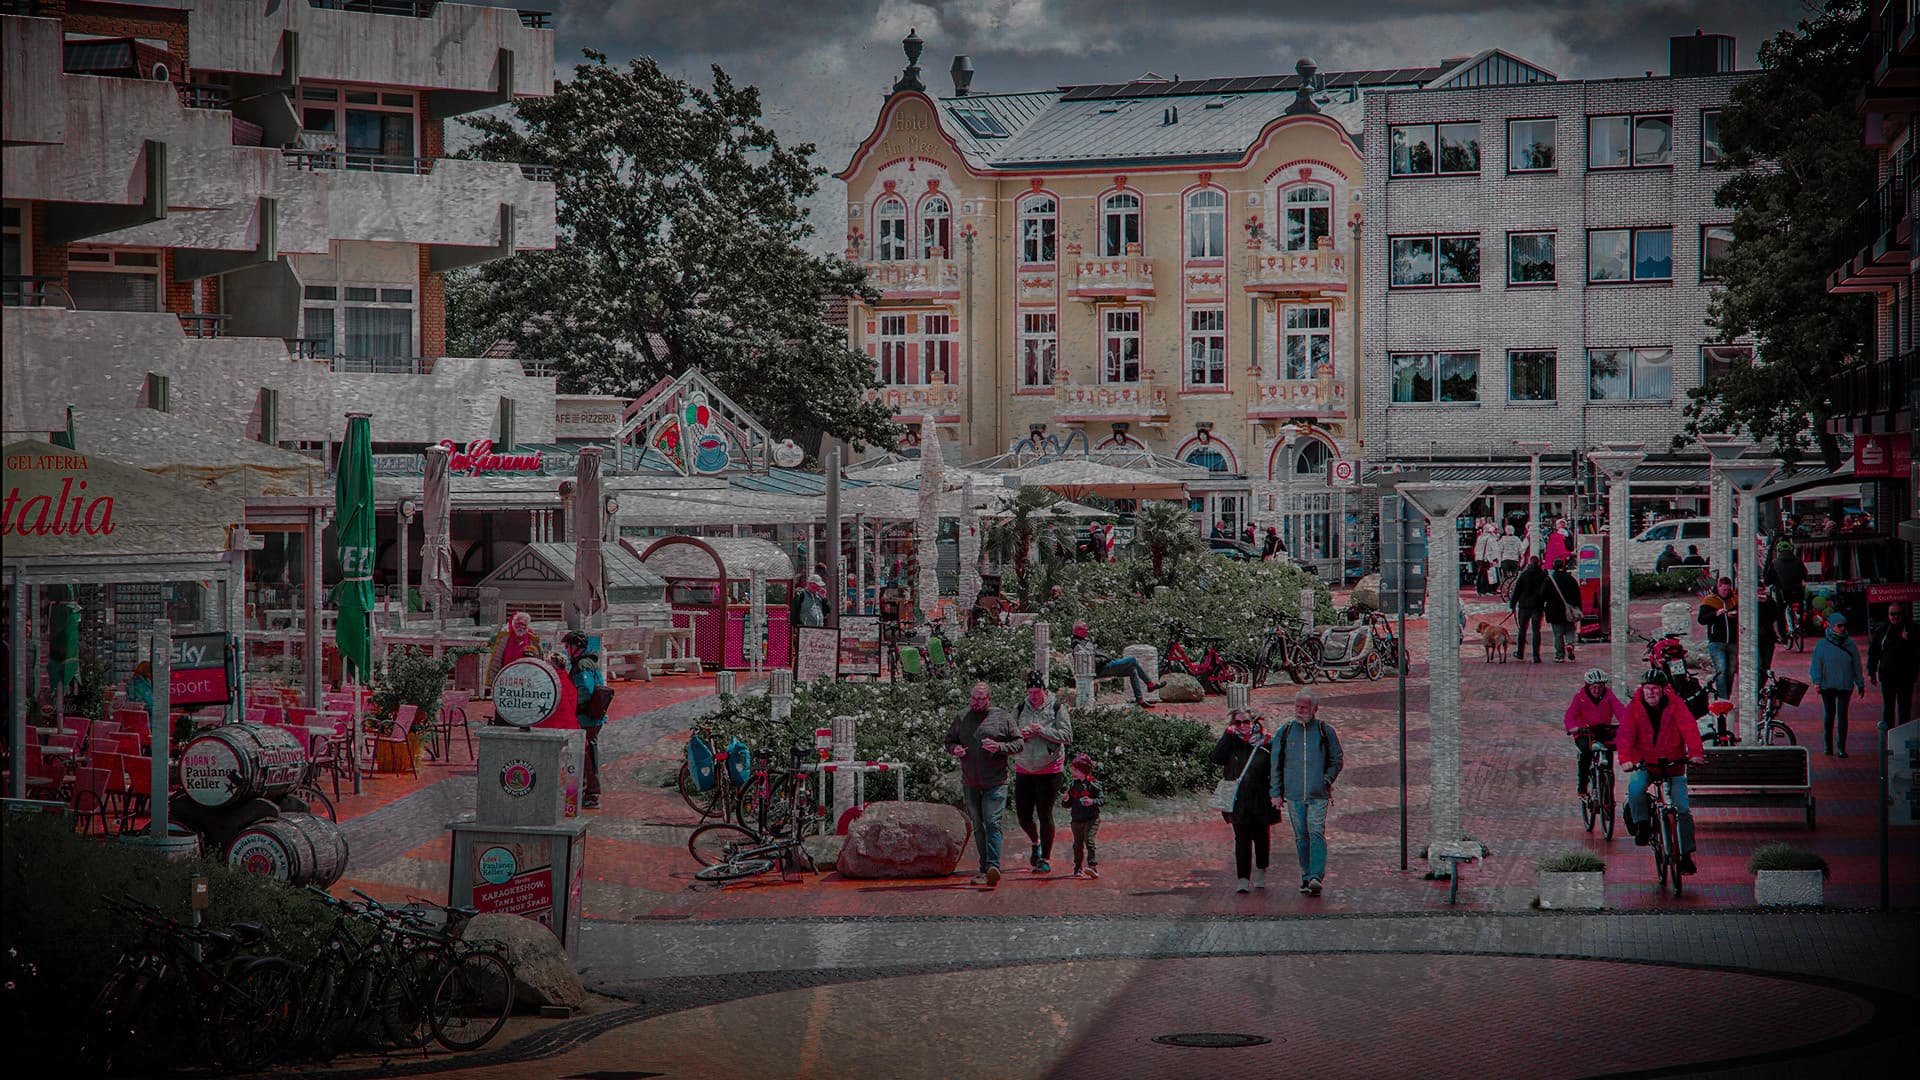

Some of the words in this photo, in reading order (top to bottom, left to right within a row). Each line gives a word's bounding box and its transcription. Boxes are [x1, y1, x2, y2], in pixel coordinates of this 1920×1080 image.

[896, 112, 929, 130] Hotel
[581, 414, 617, 424] PIZZERIA
[6, 455, 88, 470] GELATERIA
[467, 440, 543, 477] Giovanni
[169, 641, 207, 667] sky
[169, 680, 211, 696] sport
[499, 687, 552, 700] Paulaner
[499, 698, 533, 709] Keller
[186, 778, 220, 789] Keller
